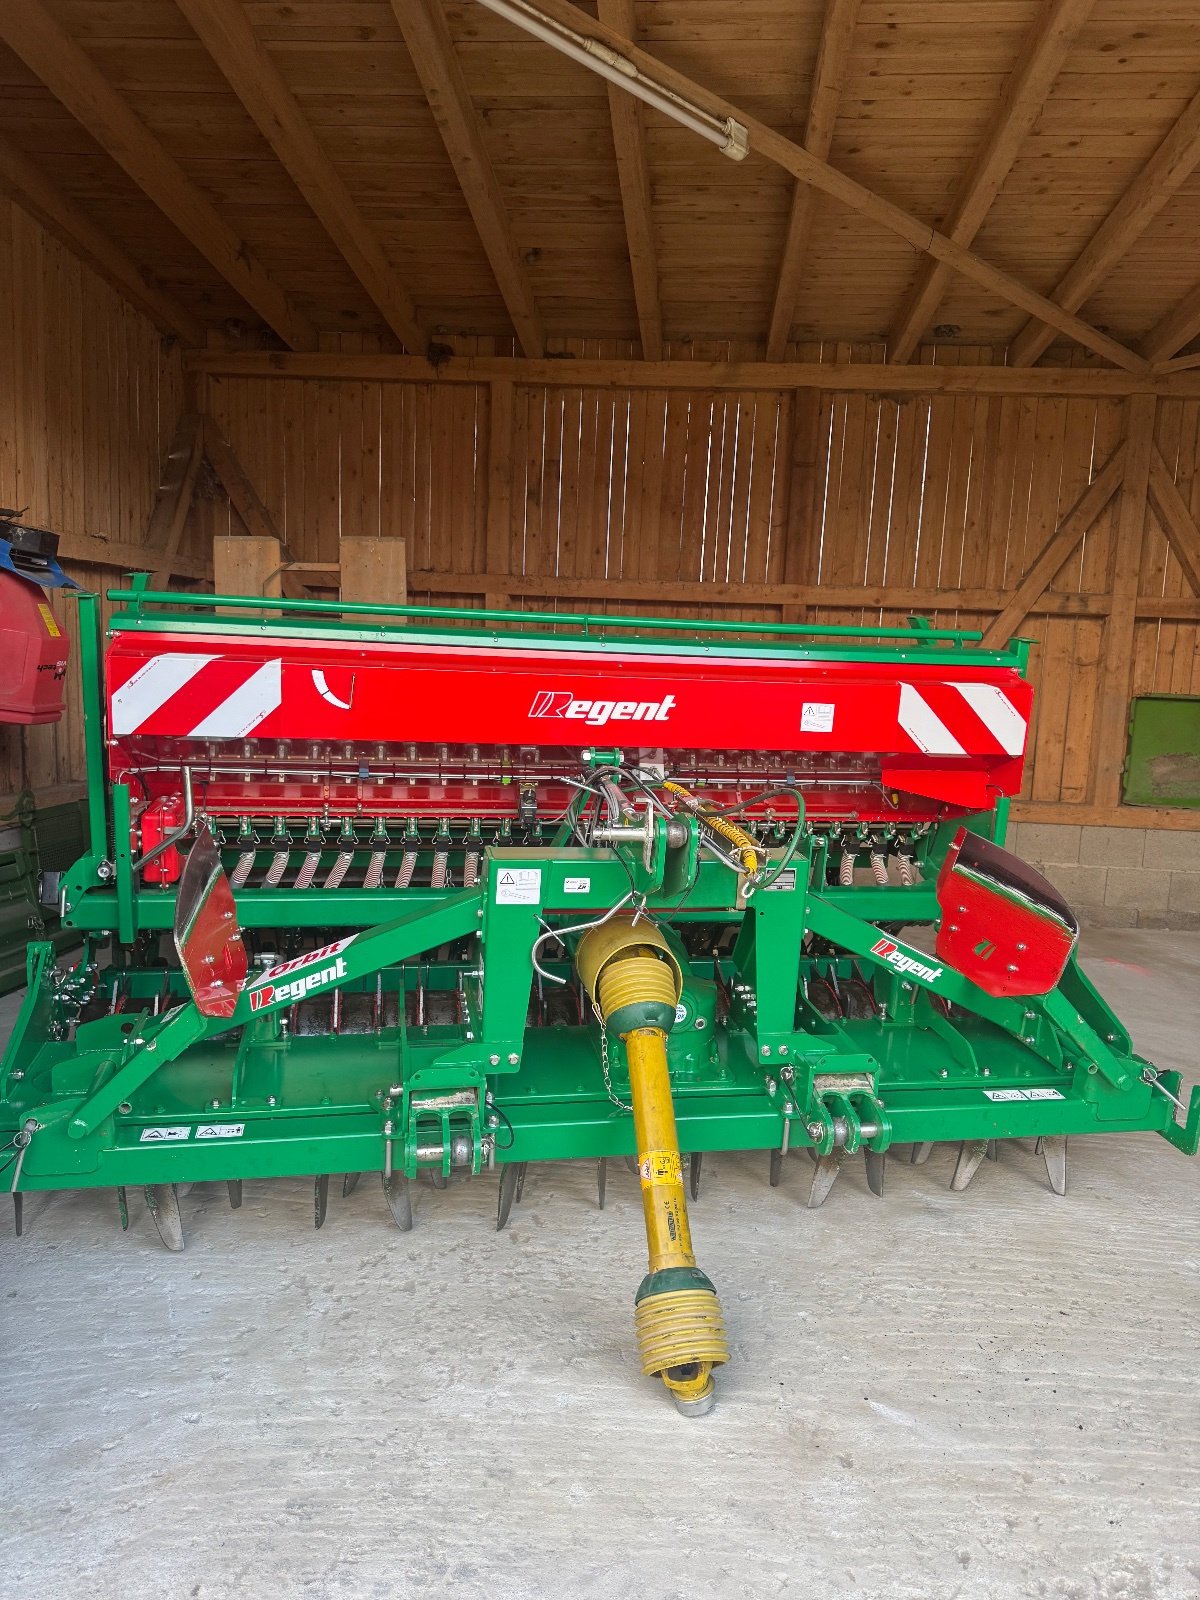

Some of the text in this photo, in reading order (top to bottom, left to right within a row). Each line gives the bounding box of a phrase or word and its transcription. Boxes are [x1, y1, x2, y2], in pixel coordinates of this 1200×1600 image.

[527, 690, 677, 726] Regent
[268, 942, 342, 978] Orbit
[869, 937, 944, 983] Regent
[249, 956, 348, 1012] Regent
